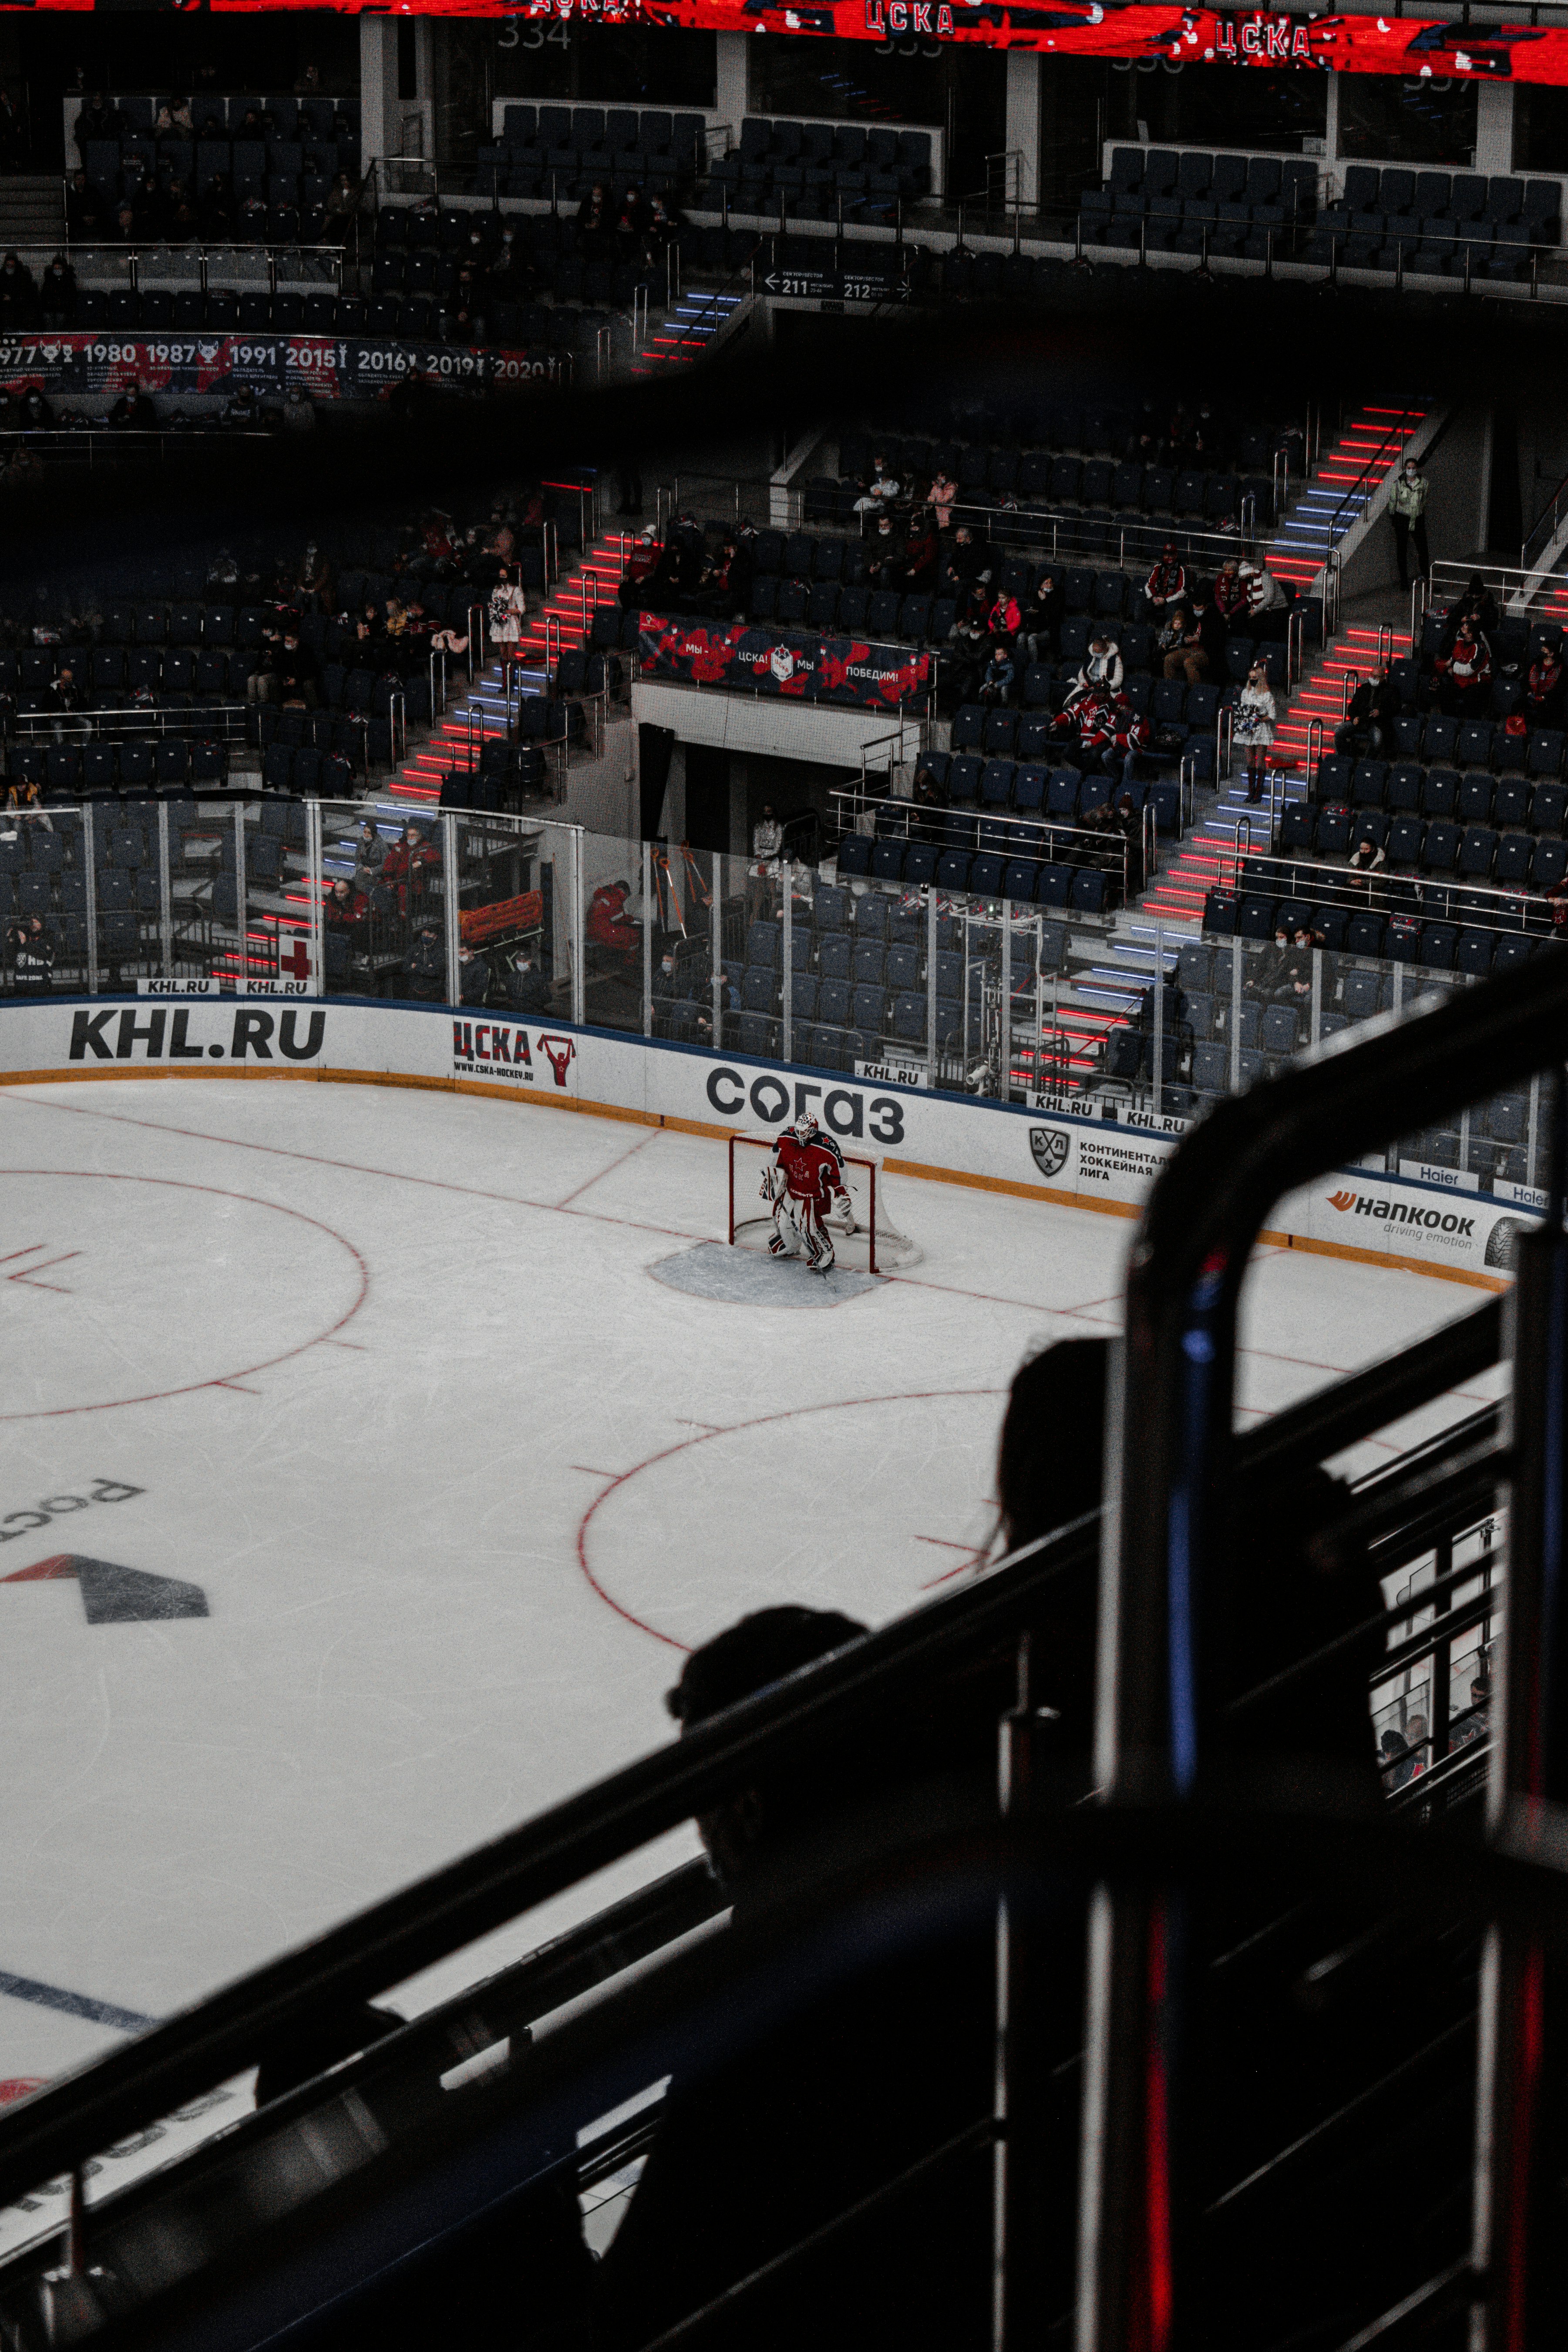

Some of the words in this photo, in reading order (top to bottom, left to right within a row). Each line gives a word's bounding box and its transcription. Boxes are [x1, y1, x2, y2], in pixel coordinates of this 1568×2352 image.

[866, 0, 955, 34] ЦСКА
[1216, 20, 1311, 57] ЦСКА
[782, 278, 808, 294] 211
[844, 283, 871, 299] 212
[0, 346, 37, 365] 977
[84, 344, 136, 363] 1980
[146, 344, 195, 363] 1987
[230, 346, 276, 365] 1991
[285, 347, 336, 368] 2015
[358, 351, 407, 371] 2016
[426, 354, 474, 375] 2019
[495, 360, 545, 379] 2020
[686, 643, 702, 655] МЫ
[739, 652, 768, 664] ЦСКА!
[797, 660, 814, 671] МЫ
[846, 666, 899, 682] ПОБЕДИМ!
[148, 980, 209, 993] KHL.RU
[246, 981, 307, 994] KHL.RU
[69, 1009, 326, 1060] KHL.RU
[454, 1022, 532, 1066] ЦСКА
[454, 1061, 533, 1082] WWW.CSKA-HOCKEY.RU
[863, 1064, 919, 1085] KHL.RU
[1036, 1095, 1092, 1117] KHL.RU
[1127, 1112, 1185, 1133] KHL.RU
[1080, 1142, 1166, 1165] КОНТИНЕНТАЛ
[789, 1164, 810, 1181] ЦСКА
[1079, 1167, 1110, 1181] ЛИГА
[1080, 1154, 1153, 1176] ХОККЕЙНАЯ
[1420, 1166, 1459, 1185] Haier
[1383, 1223, 1422, 1241] driving
[1426, 1233, 1472, 1250] emotion
